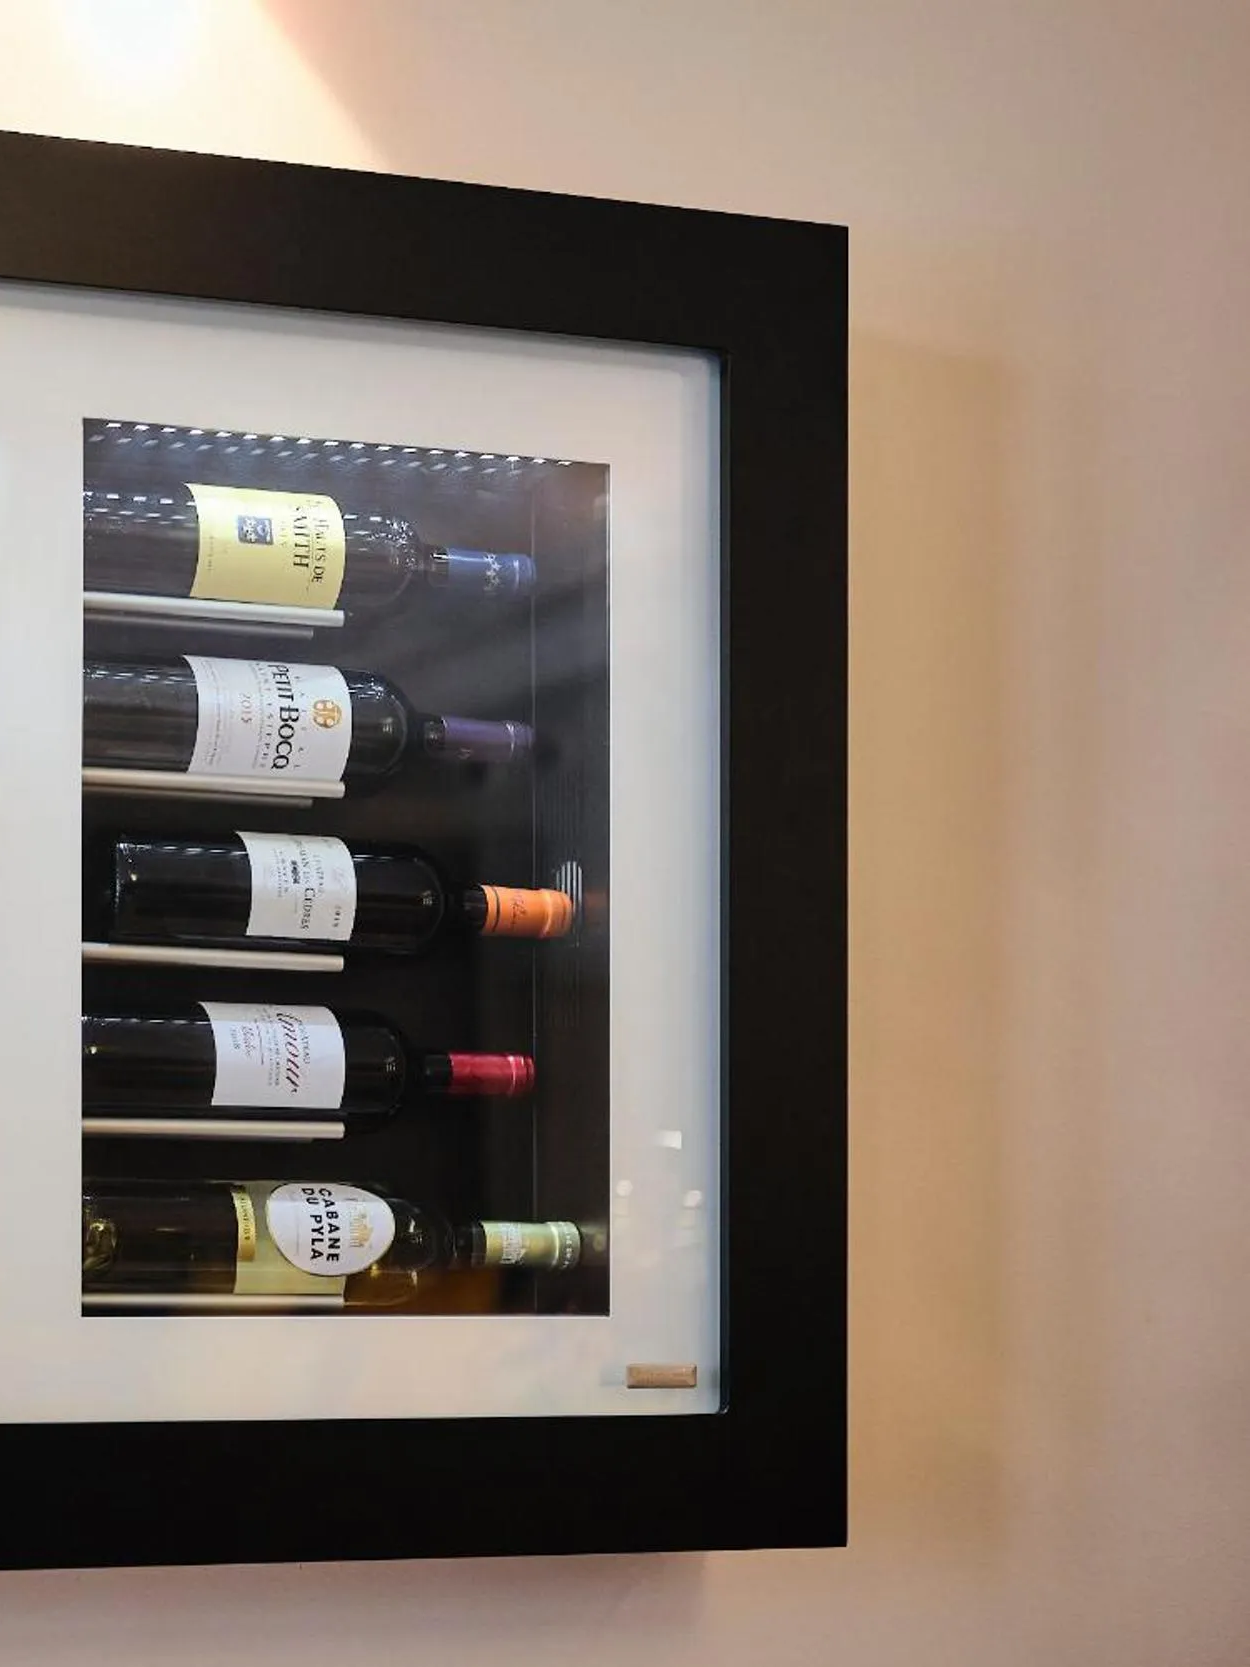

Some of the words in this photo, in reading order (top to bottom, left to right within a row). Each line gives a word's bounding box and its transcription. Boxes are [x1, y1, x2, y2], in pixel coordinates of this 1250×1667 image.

[311, 566, 325, 584] DE
[267, 664, 294, 702] PETIT
[271, 705, 300, 770] BOCQ
[301, 1187, 320, 1205] DU
[310, 1214, 325, 1261] PYLA
[318, 1188, 341, 1262] CABANE
